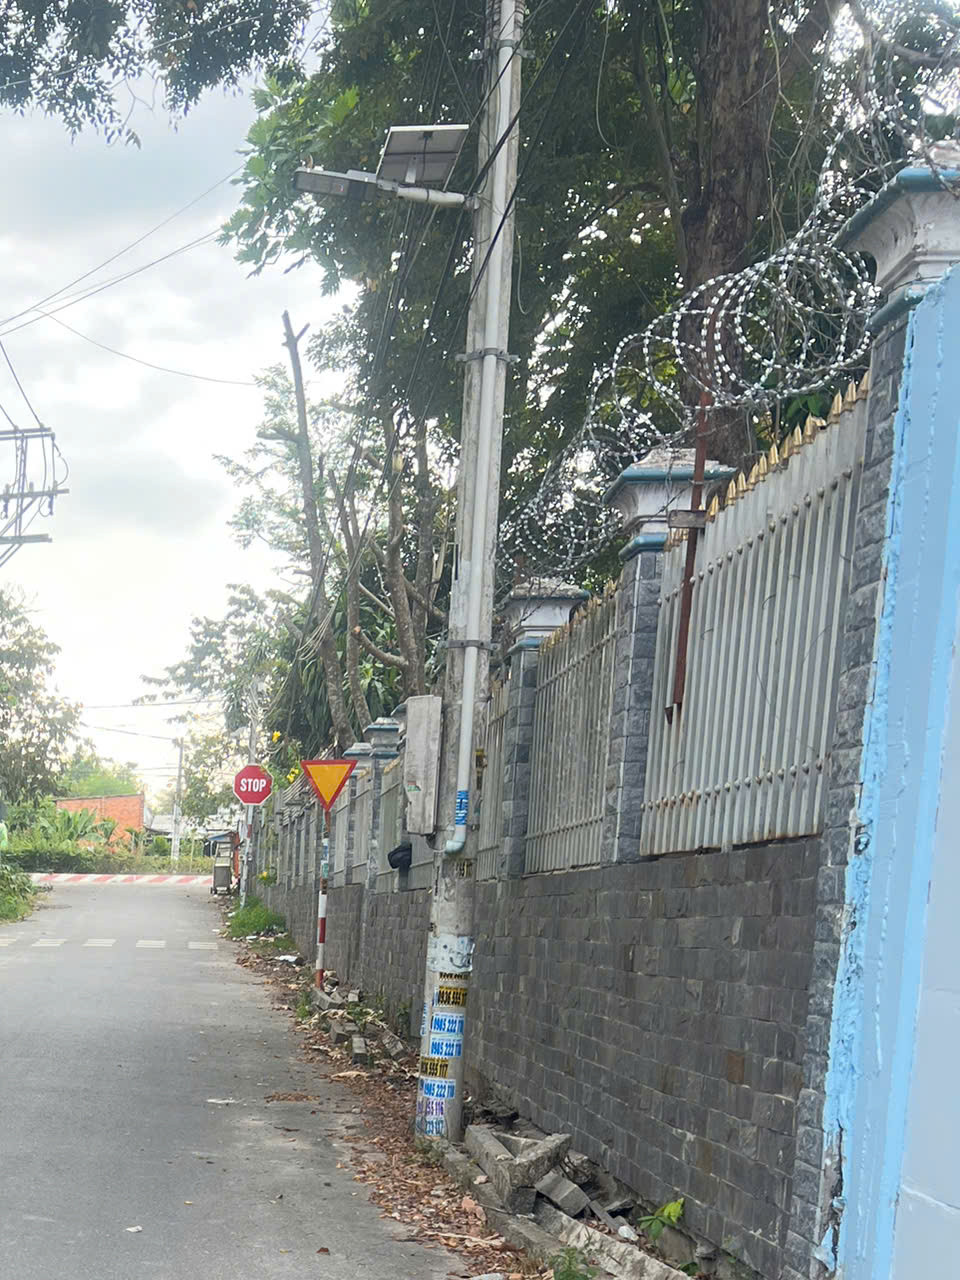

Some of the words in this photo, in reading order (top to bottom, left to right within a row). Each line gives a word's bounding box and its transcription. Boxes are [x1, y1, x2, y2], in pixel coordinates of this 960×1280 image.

[240, 778, 267, 793] STOP
[447, 1017, 457, 1033] 222
[444, 1042, 454, 1057] 222
[436, 1084, 446, 1098] 222
